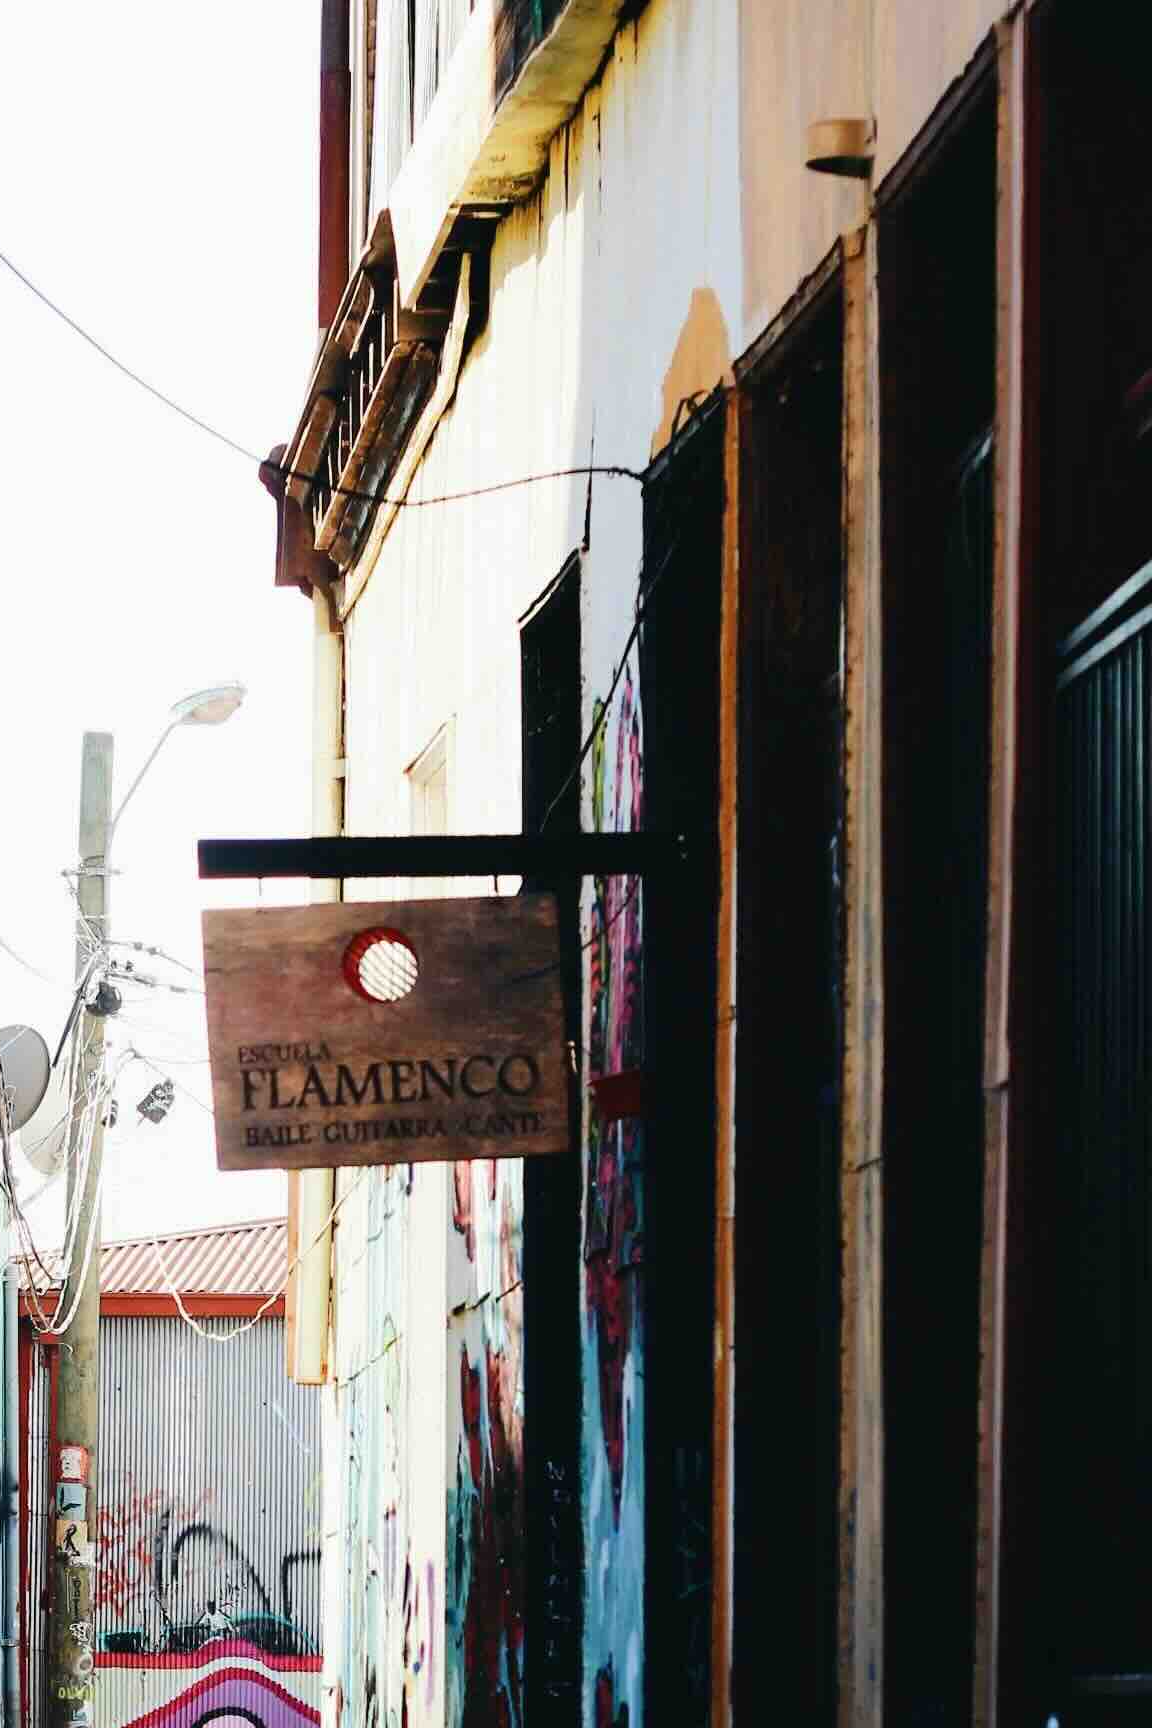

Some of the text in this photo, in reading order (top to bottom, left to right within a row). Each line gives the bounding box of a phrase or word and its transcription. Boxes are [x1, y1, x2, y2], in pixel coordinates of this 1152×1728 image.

[238, 1042, 331, 1064] ESCUELA
[240, 1054, 539, 1111] FLAMENCO
[244, 1121, 313, 1147] BAILE
[321, 1117, 447, 1145] GUITARRA
